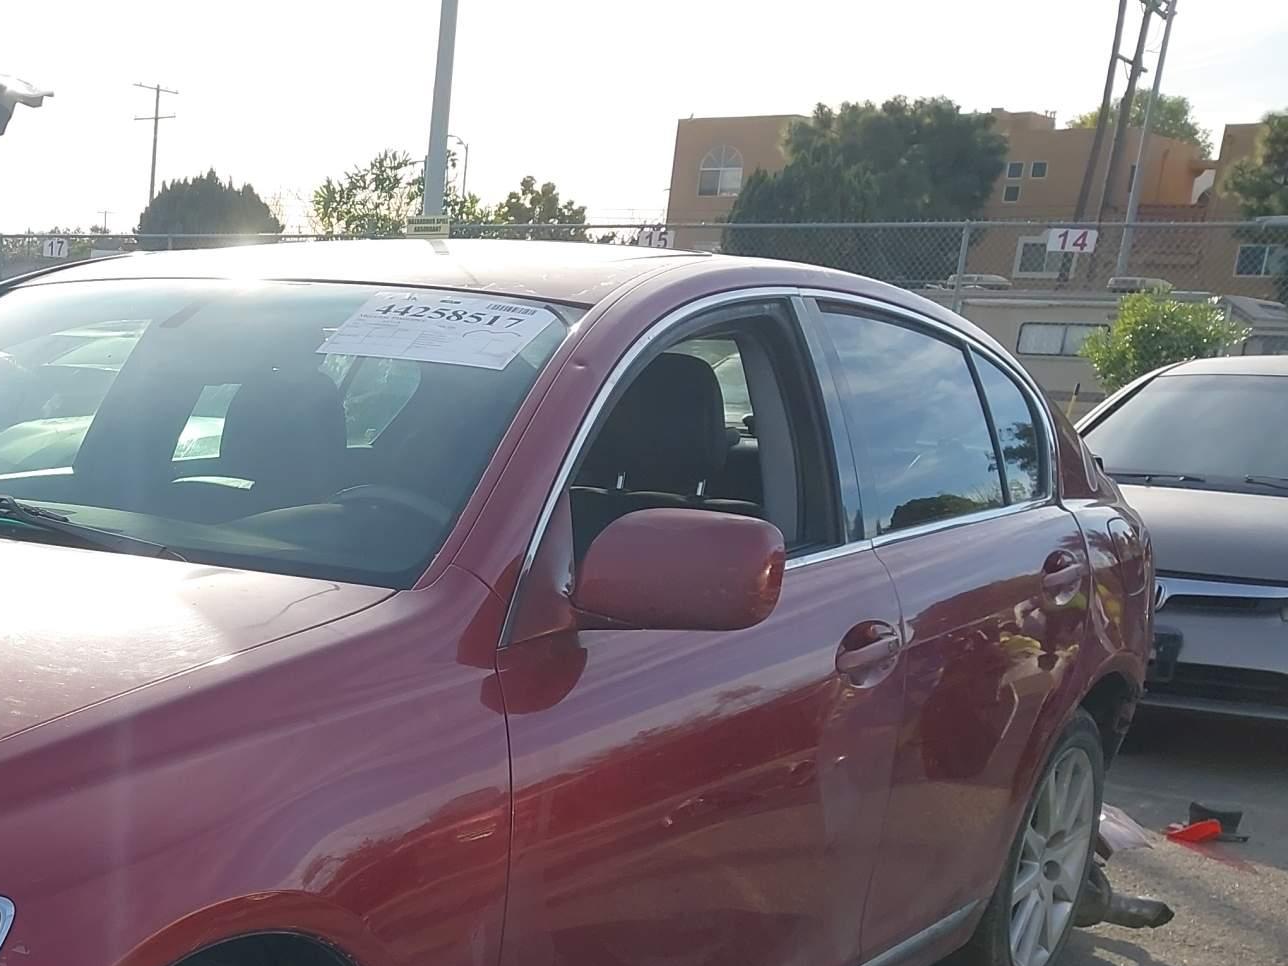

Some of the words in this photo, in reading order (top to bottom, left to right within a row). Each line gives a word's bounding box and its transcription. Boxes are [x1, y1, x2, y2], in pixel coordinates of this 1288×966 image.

[48, 240, 65, 256] 17
[645, 230, 669, 248] 15
[1057, 229, 1089, 251] 14
[376, 303, 525, 328] 44258517
